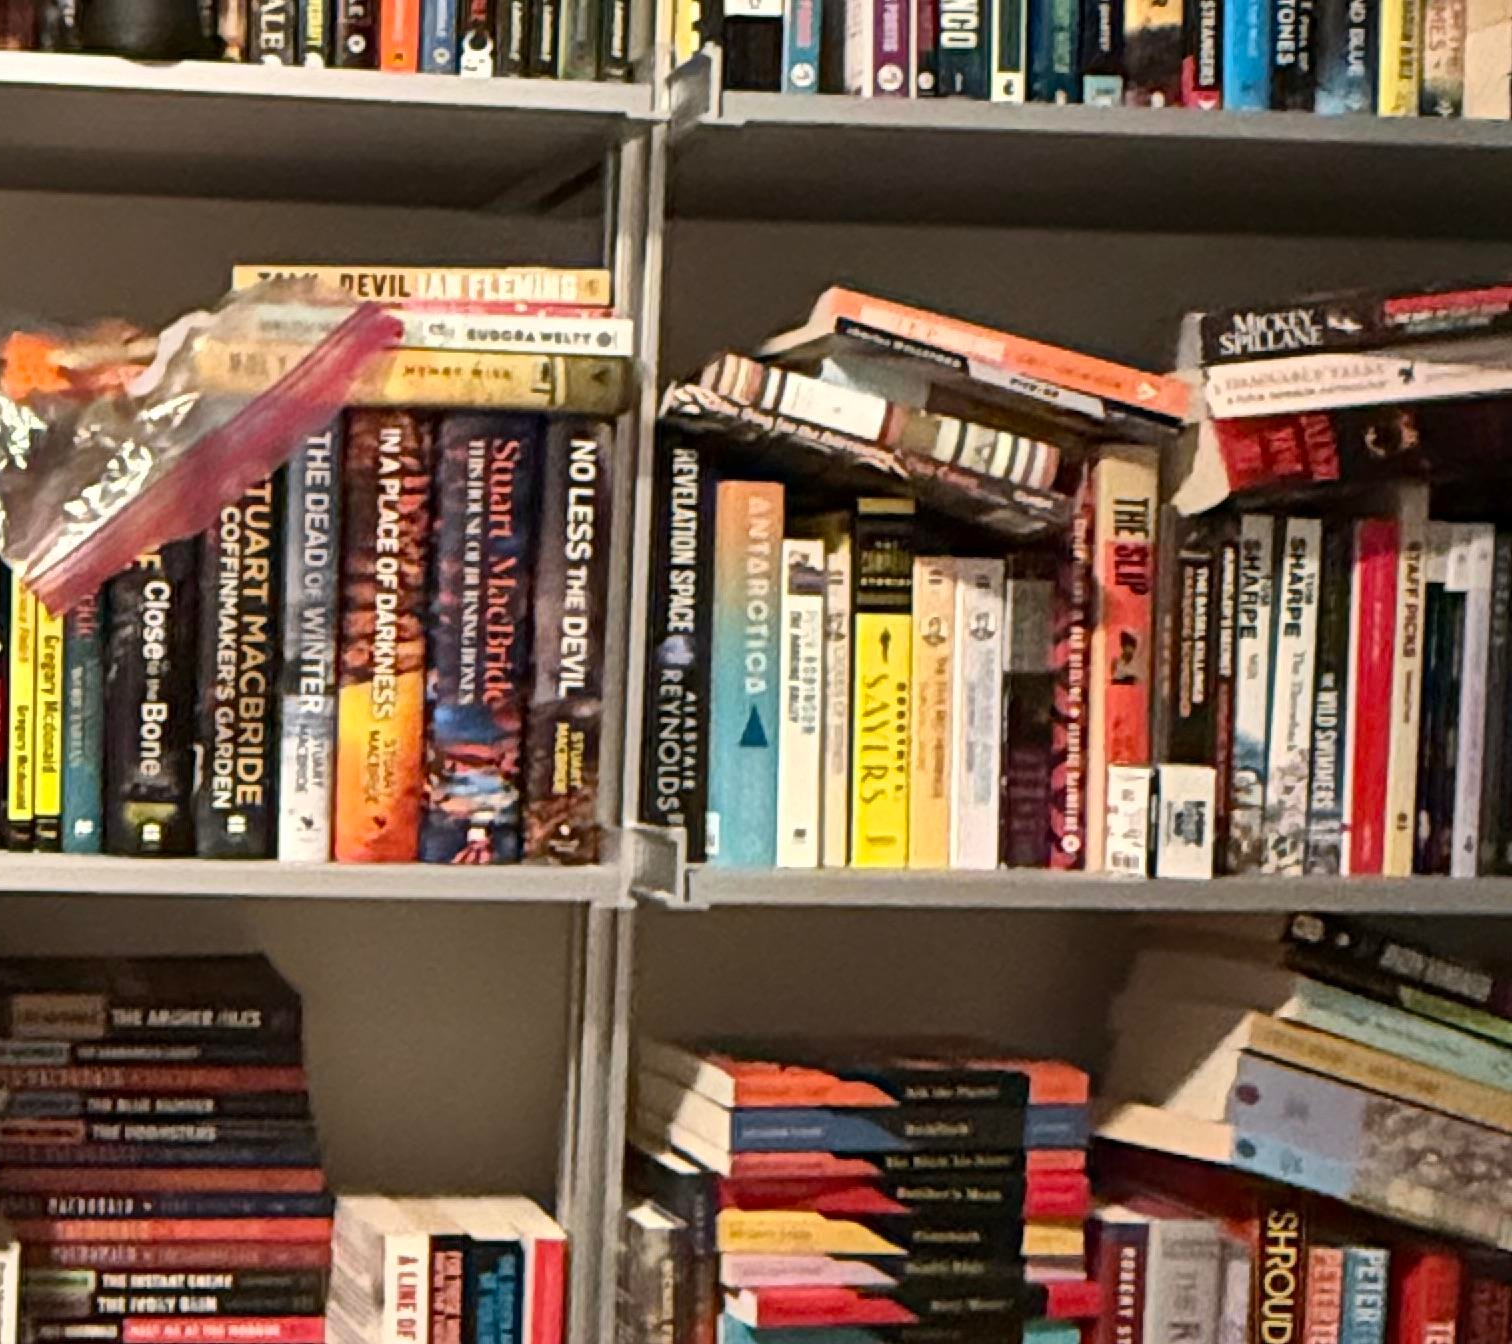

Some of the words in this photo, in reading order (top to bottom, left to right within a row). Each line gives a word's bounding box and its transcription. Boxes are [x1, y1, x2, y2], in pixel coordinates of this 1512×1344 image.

[1219, 326, 1324, 354] SPILLANE
[1231, 308, 1317, 334] MICKEY
[306, 433, 331, 485] THE
[375, 428, 401, 453] IN
[375, 455, 398, 475] A
[570, 439, 596, 481] NO
[377, 479, 401, 555] PLACE
[491, 439, 520, 540] Stuart
[567, 488, 595, 560] LESS
[669, 448, 698, 562] REVELATION
[1114, 498, 1149, 538] THE
[305, 494, 330, 569] DEAD
[214, 507, 241, 701] COFFINMAKER'S
[374, 560, 397, 589] OF
[565, 564, 588, 611] THE
[669, 569, 696, 634] SPACE
[746, 495, 773, 695] ANTARCTICA
[1114, 544, 1148, 596] SLIP
[1283, 537, 1307, 638] SHARPE
[143, 581, 170, 662] Close
[299, 605, 327, 714] WINTER
[372, 593, 397, 719] DARKNESS
[483, 556, 516, 703] MacBride
[560, 618, 589, 697] DEVIL
[139, 702, 168, 775] Bone
[234, 616, 268, 806] MACBRIDE
[657, 668, 684, 814] REYNOLDS
[213, 708, 234, 809] GARDEN
[1263, 1211, 1298, 1344] SHROUD
